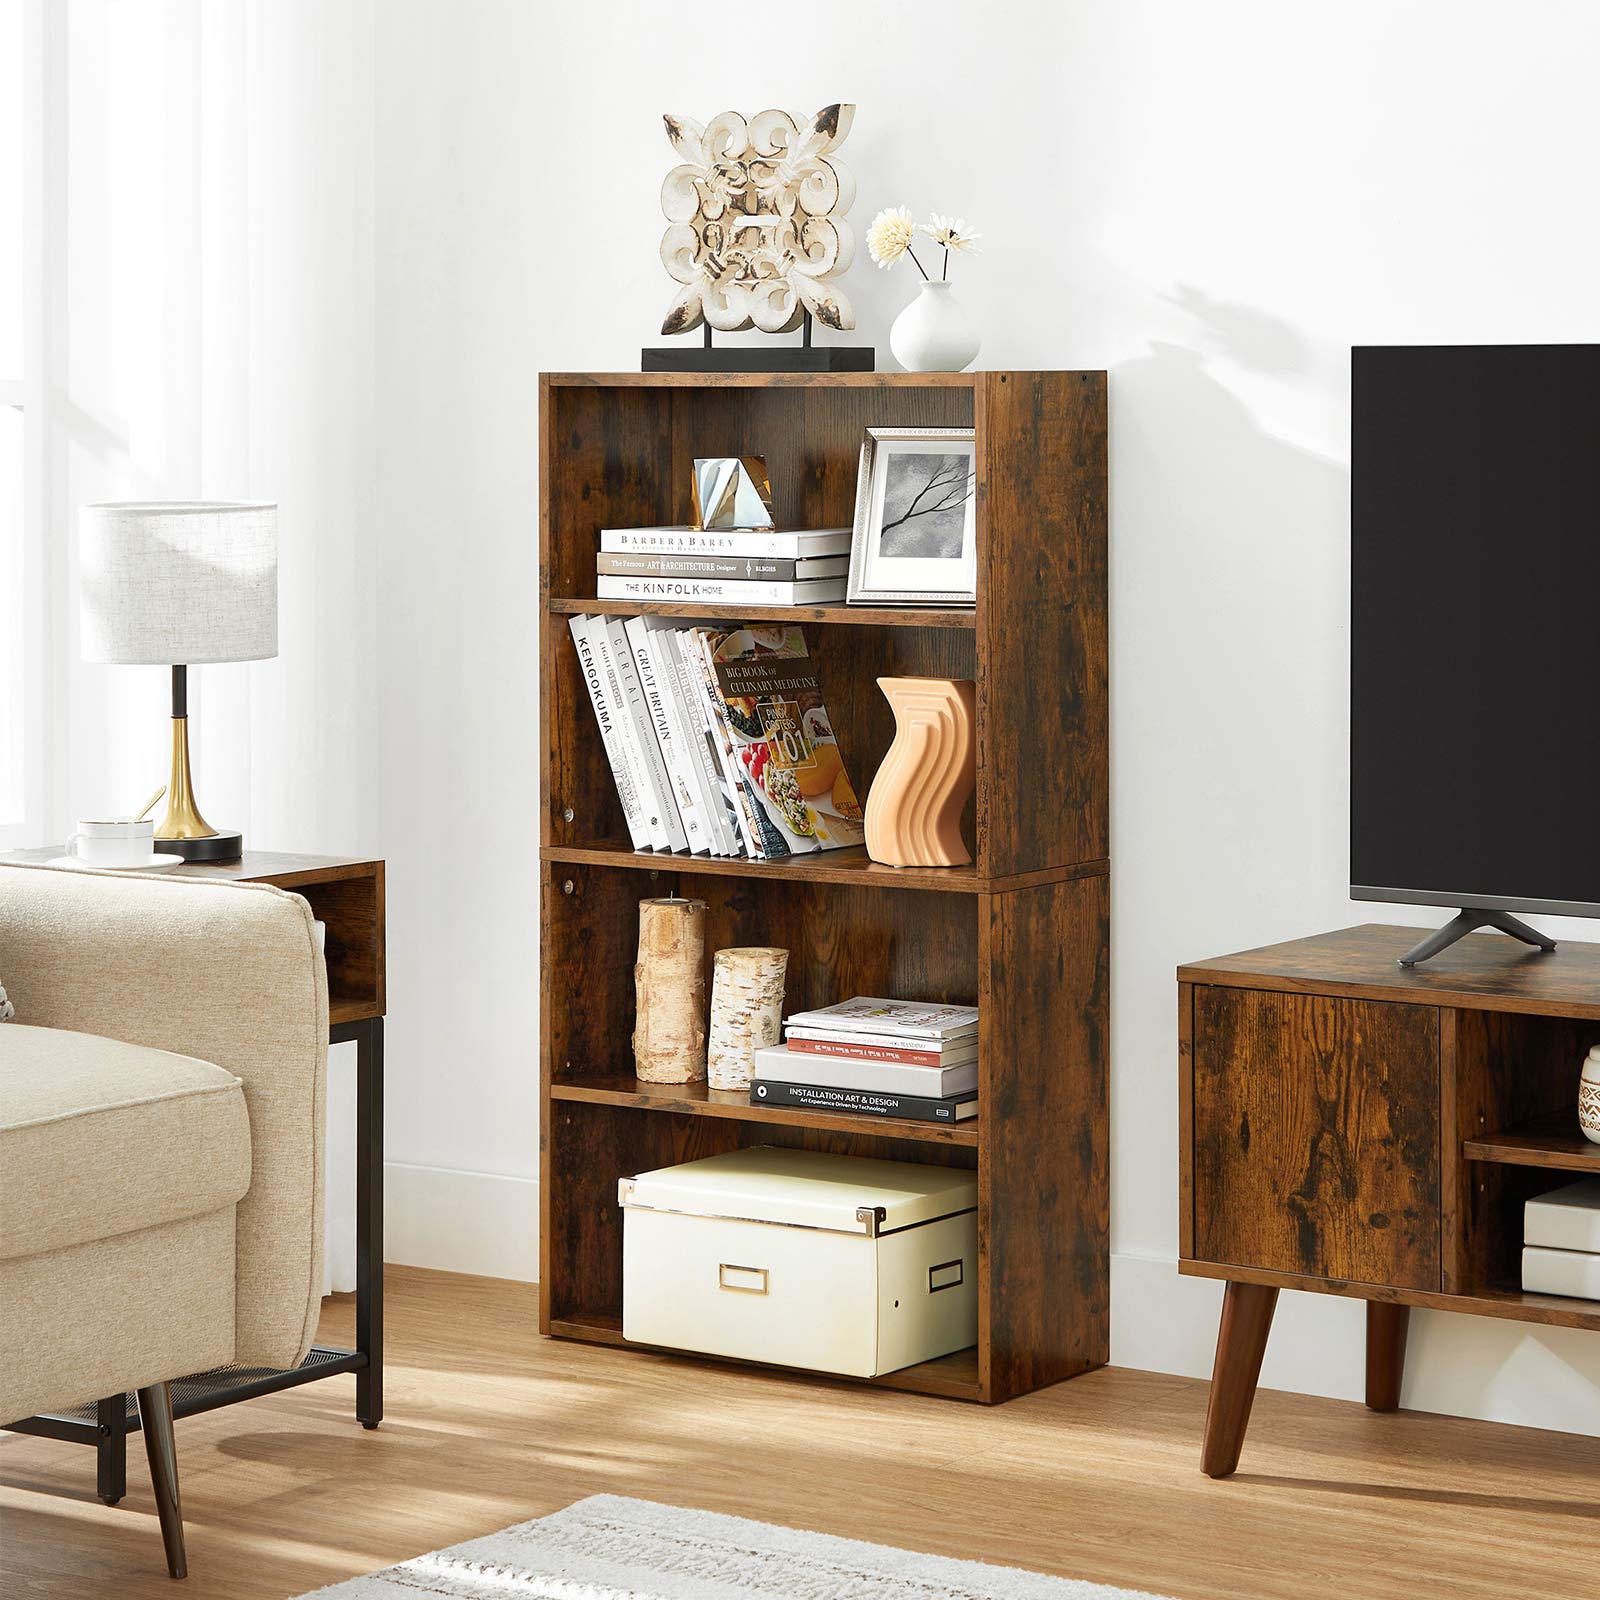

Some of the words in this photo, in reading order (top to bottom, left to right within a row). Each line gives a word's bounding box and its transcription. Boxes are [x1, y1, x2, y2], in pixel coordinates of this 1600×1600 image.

[621, 535, 683, 545] BARBERA
[689, 537, 734, 547] BAREY
[623, 560, 645, 568] Famous
[647, 560, 660, 570] ART
[666, 561, 716, 571] ARCHITECTURE
[626, 583, 640, 592] THE
[643, 583, 700, 595] KINFOLK
[702, 586, 723, 595] HOME
[614, 638, 640, 705] CEREAL
[725, 667, 742, 678] BIG
[742, 666, 768, 678] BOOK
[768, 667, 776, 675] OF
[578, 637, 613, 734] KENGOKUMA
[607, 669, 624, 708] DESIGNS
[637, 648, 656, 689] GREAT
[650, 691, 671, 741] BRITAIN
[730, 679, 774, 693] CULINARY
[774, 677, 818, 690] MEDICINE
[676, 663, 694, 704] PUBLIC
[688, 705, 705, 743] SPACE
[699, 744, 718, 786] DESIGN
[771, 730, 809, 762] 101
[643, 732, 651, 745] want
[666, 809, 675, 829] things
[789, 1088, 844, 1101] INSTALLATION
[845, 1094, 860, 1103] ART
[861, 1095, 869, 1105] &
[869, 1096, 899, 1107] DESIGN
[807, 1098, 834, 1107] Experience
[858, 1104, 887, 1113] Technology
